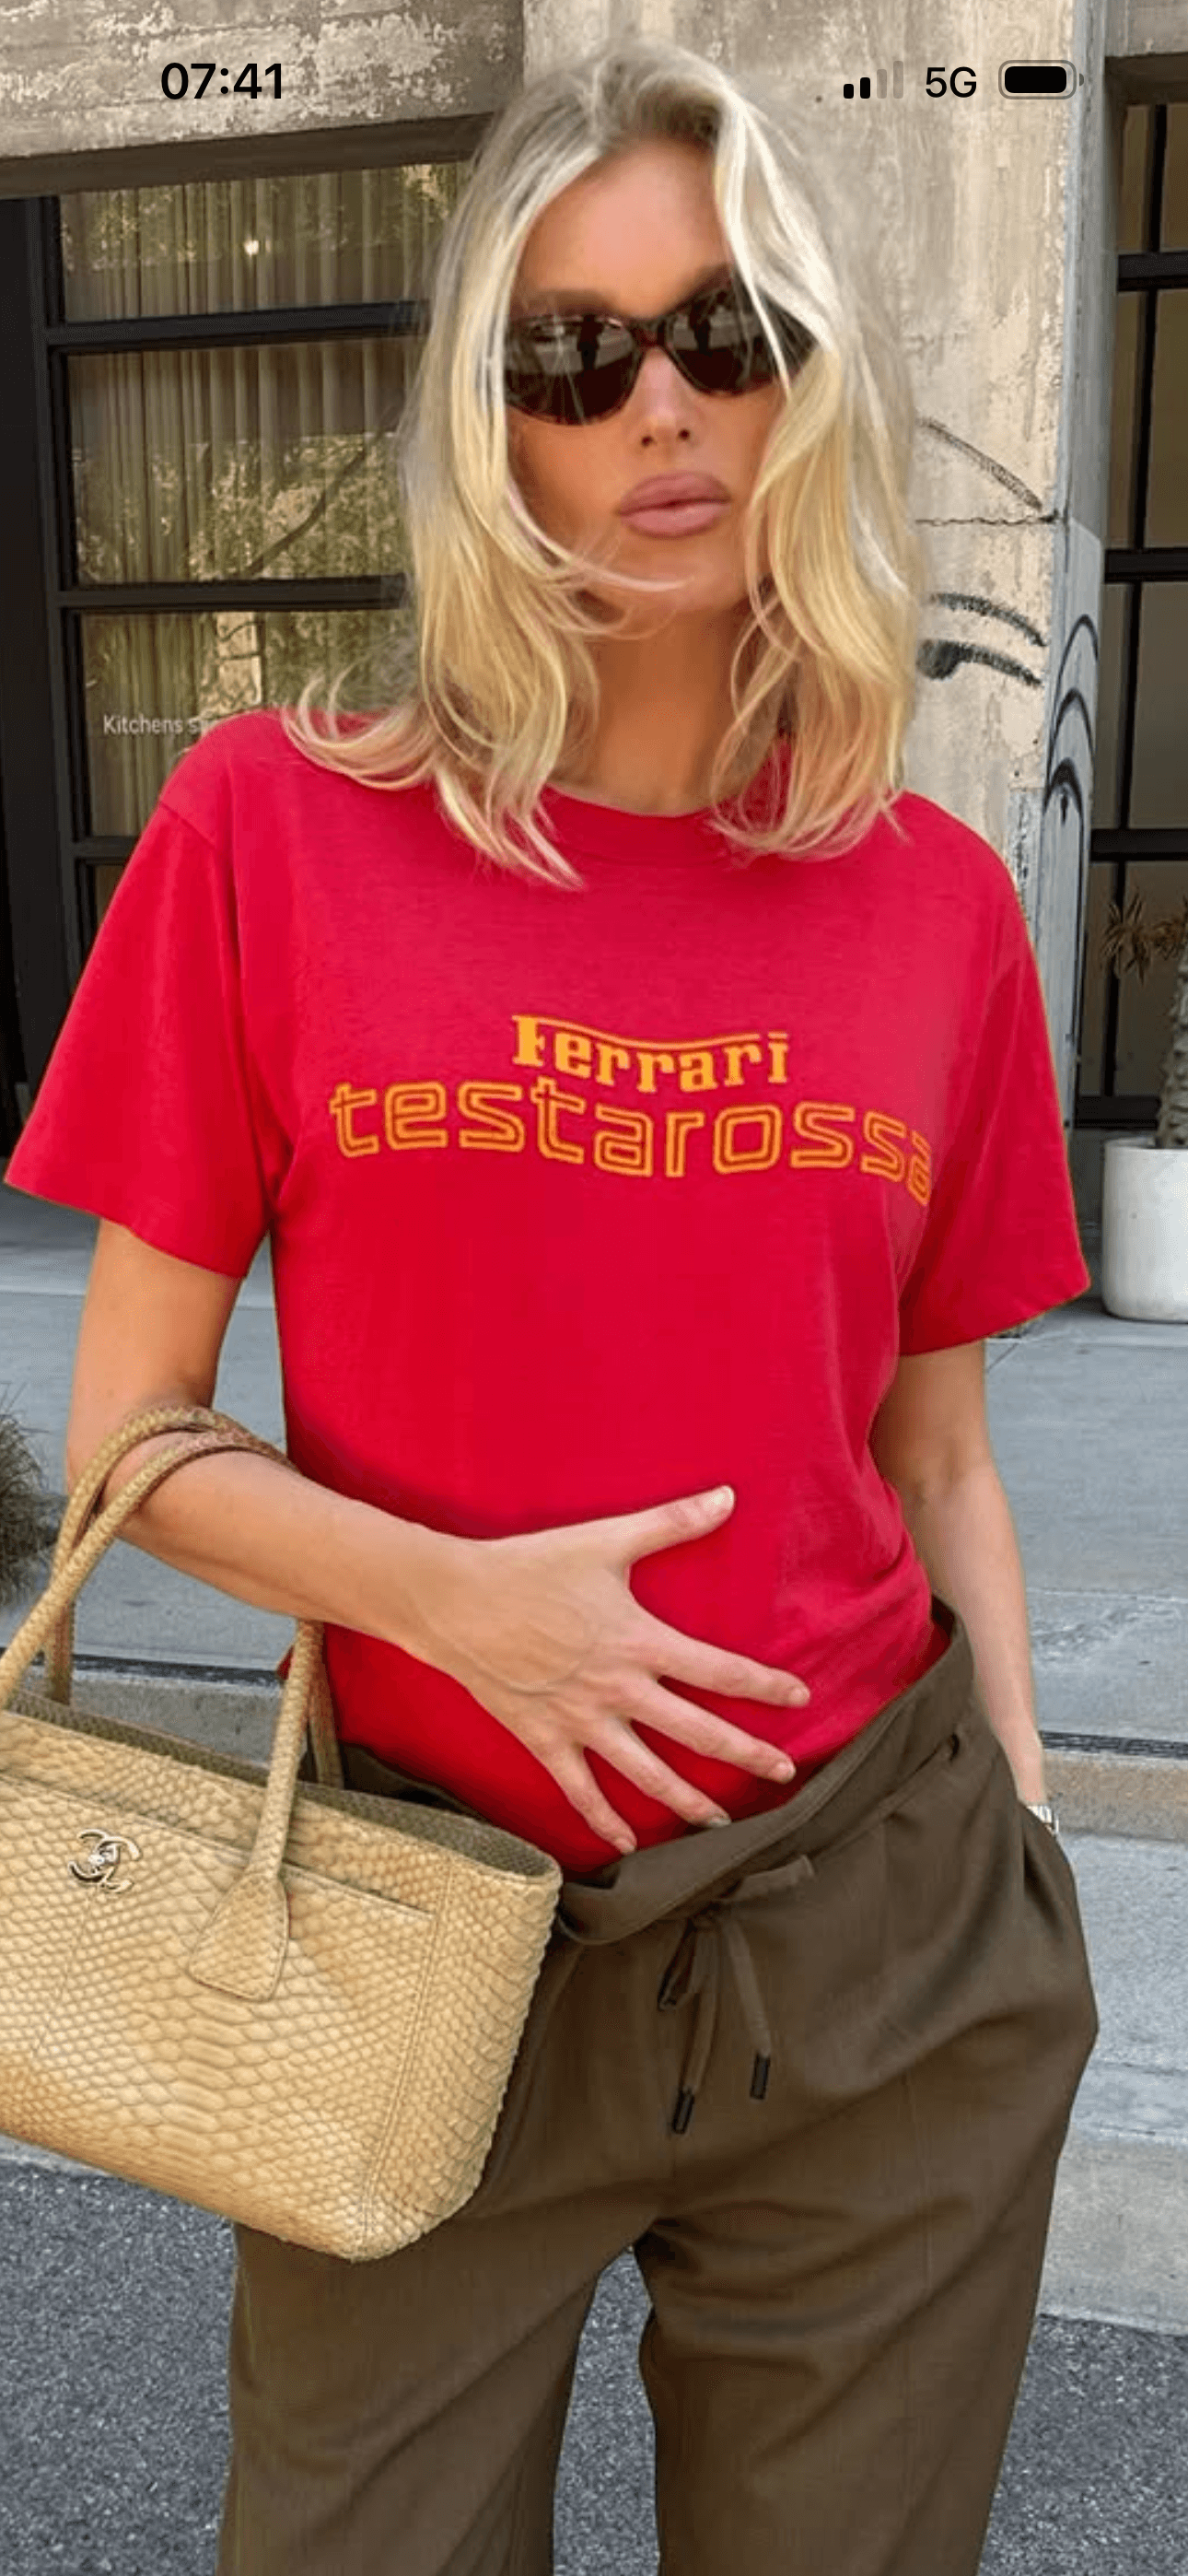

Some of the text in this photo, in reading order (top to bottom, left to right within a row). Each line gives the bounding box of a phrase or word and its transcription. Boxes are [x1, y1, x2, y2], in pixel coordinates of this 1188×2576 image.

[103, 713, 183, 734] Kitchens
[511, 1014, 788, 1094] Ferrari
[330, 1075, 932, 1207] testarossa
